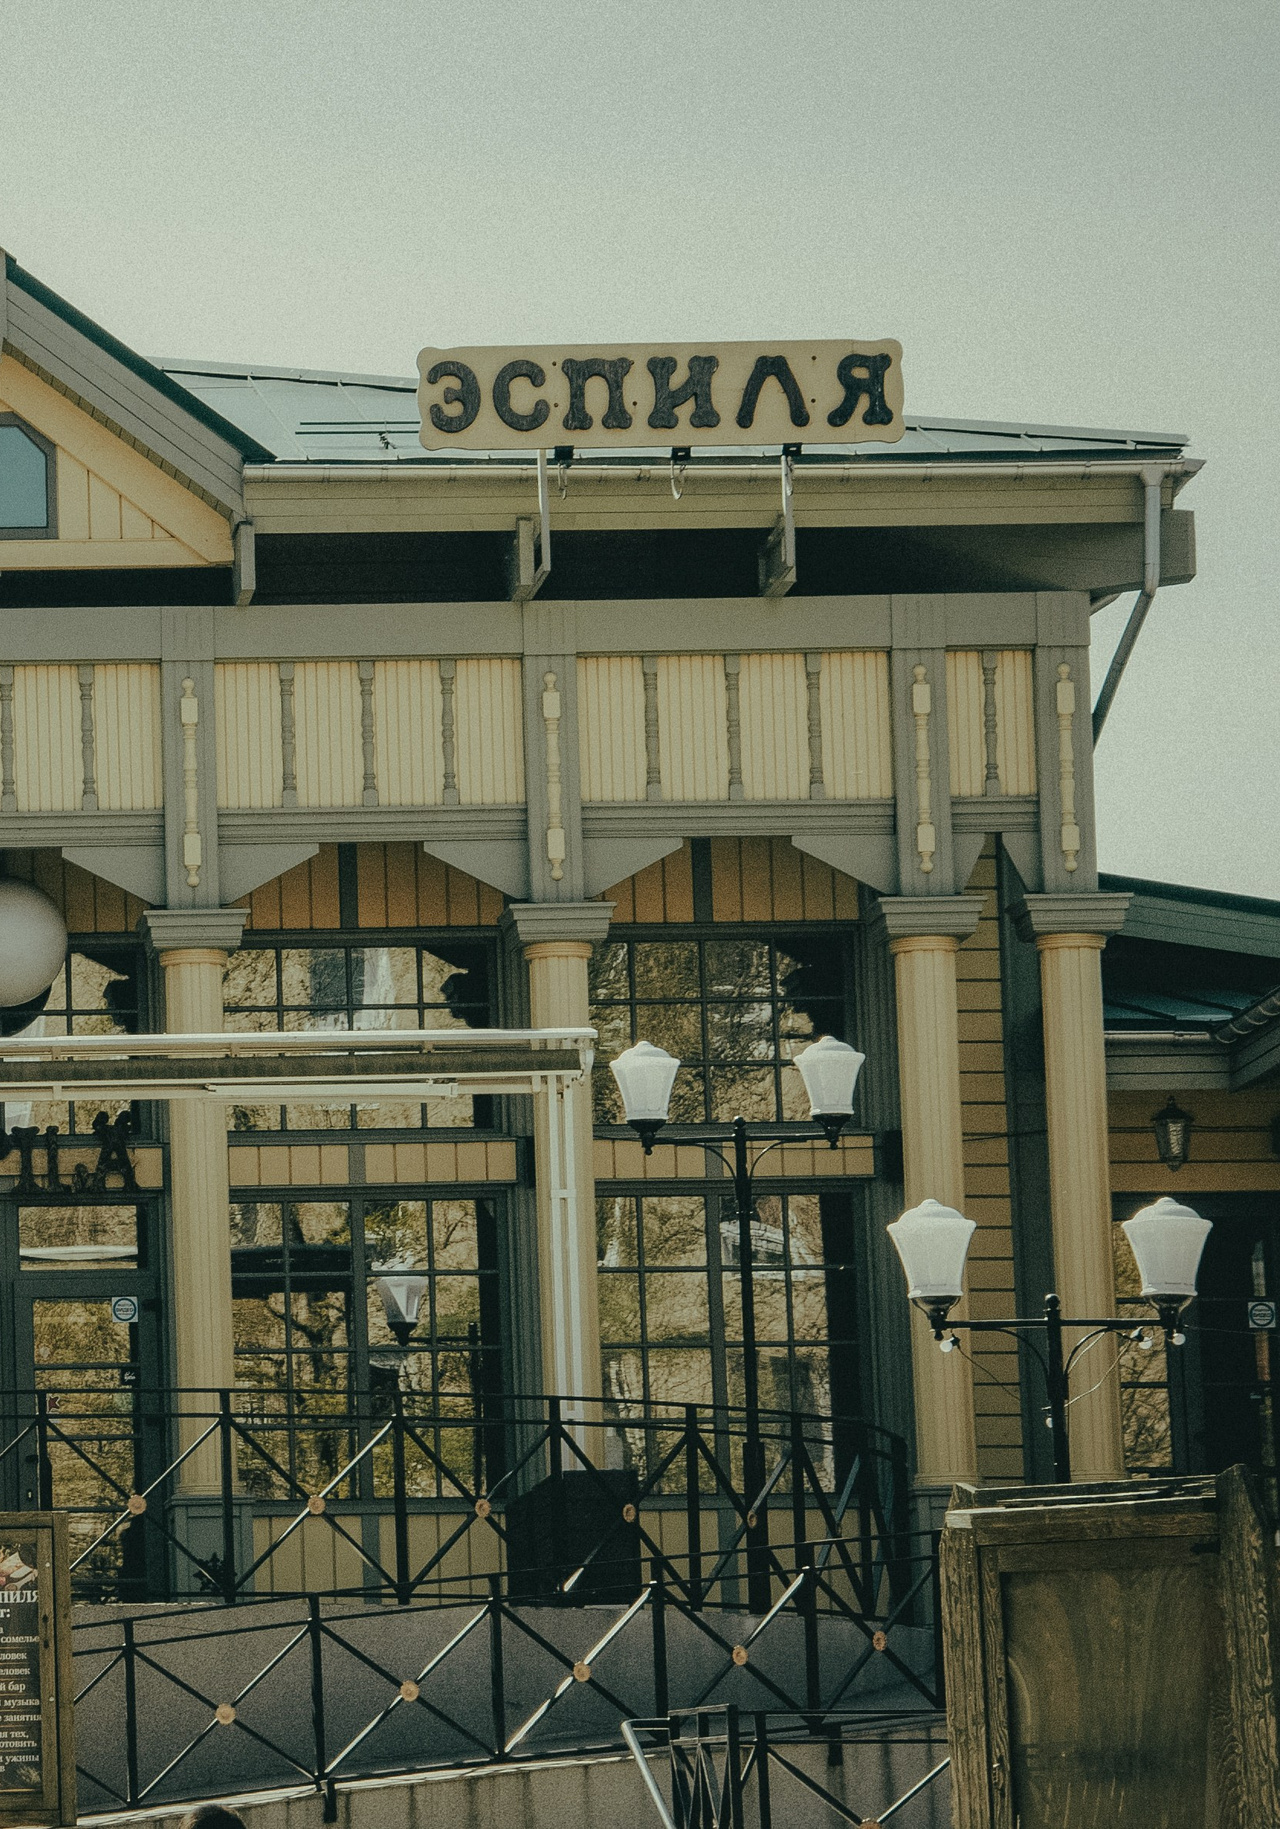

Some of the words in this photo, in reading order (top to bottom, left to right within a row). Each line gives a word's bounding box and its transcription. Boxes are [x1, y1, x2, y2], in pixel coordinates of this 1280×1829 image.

[426, 352, 894, 433] ЭСПИЛЯ
[8, 1681, 26, 1693] бар
[3, 1698, 40, 1709] музыка
[5, 1753, 40, 1764] ужины
